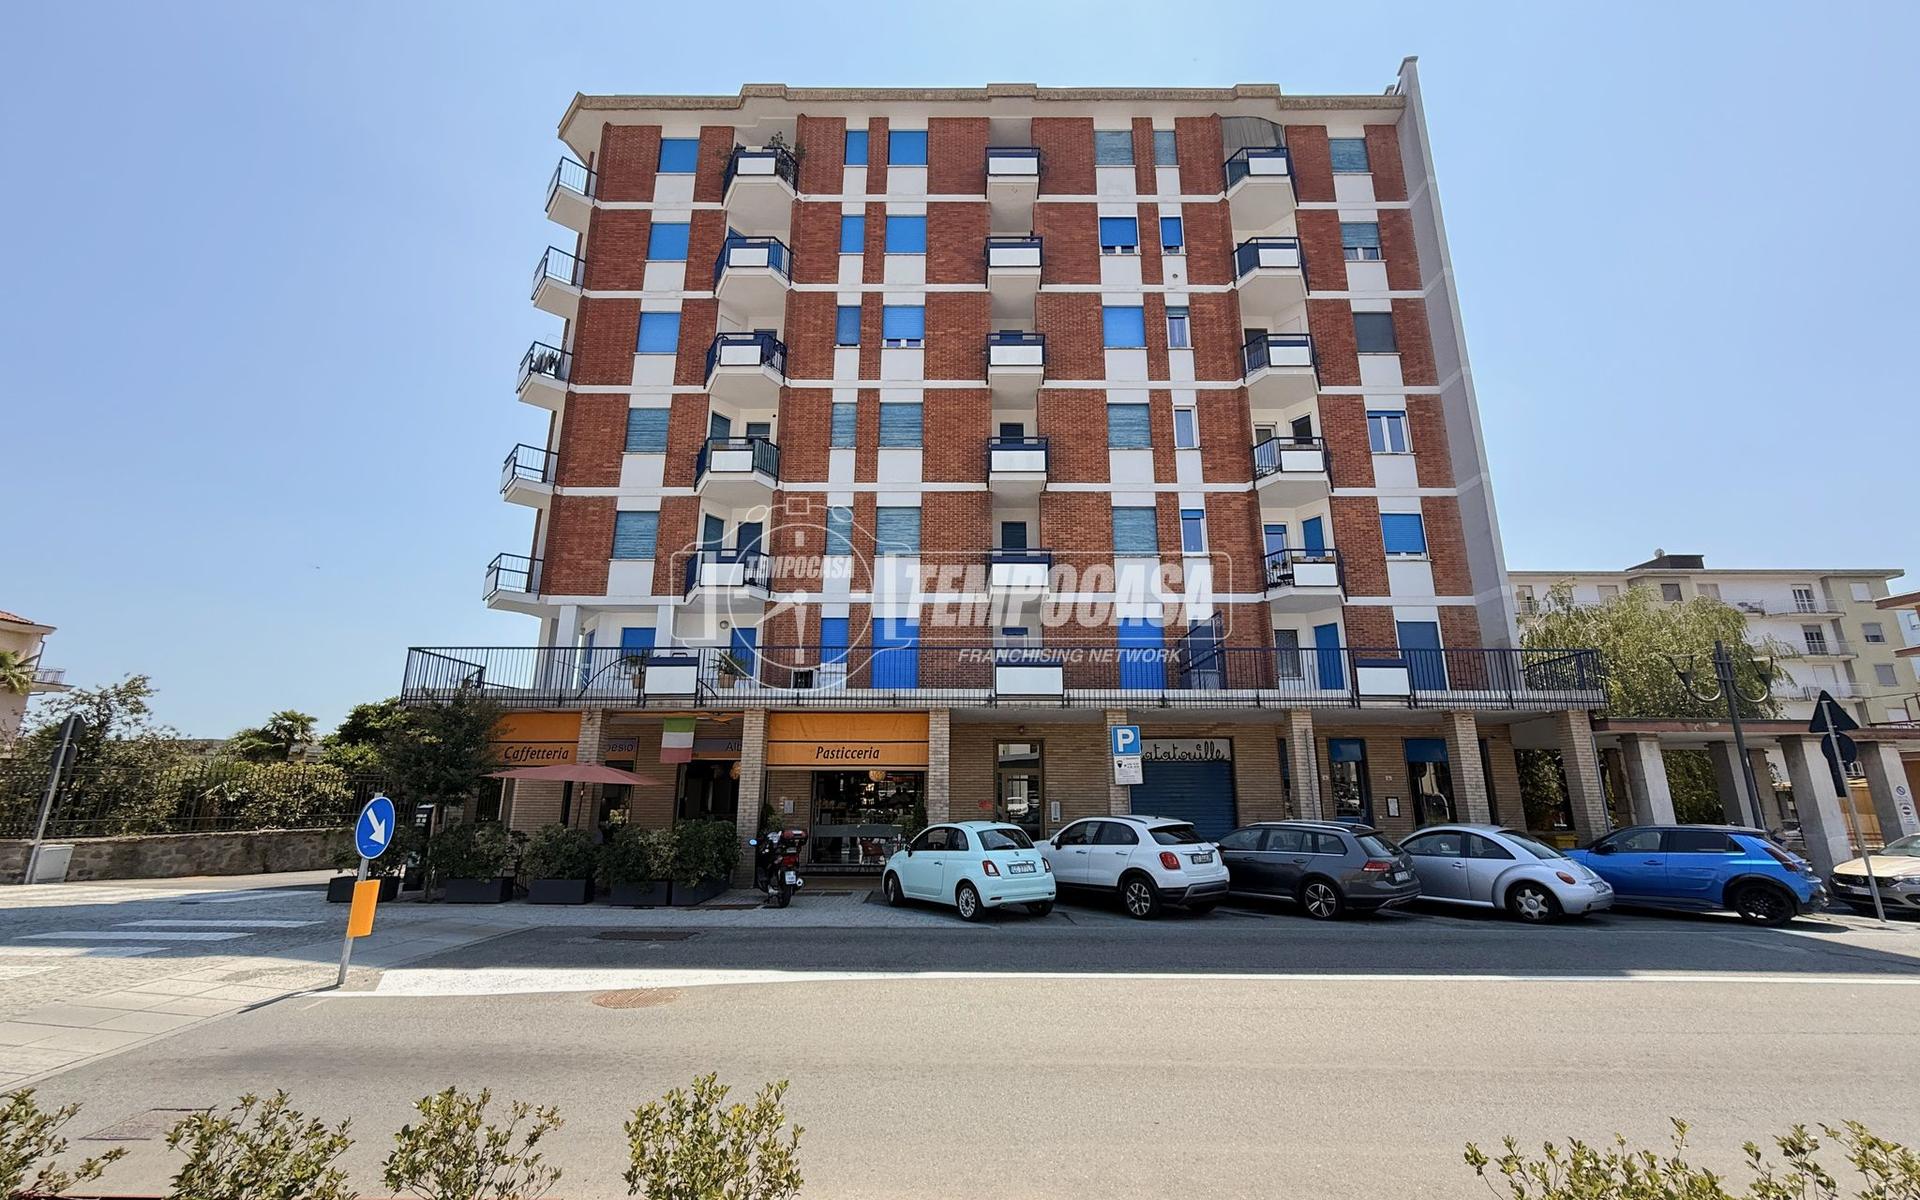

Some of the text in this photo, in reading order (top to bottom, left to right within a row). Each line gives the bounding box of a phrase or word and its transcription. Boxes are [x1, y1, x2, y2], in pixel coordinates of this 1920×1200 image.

[1117, 729, 1135, 752] P
[504, 746, 569, 761] Caffetteria
[815, 746, 880, 760] Pasticceria
[1141, 741, 1226, 761] atatouille
